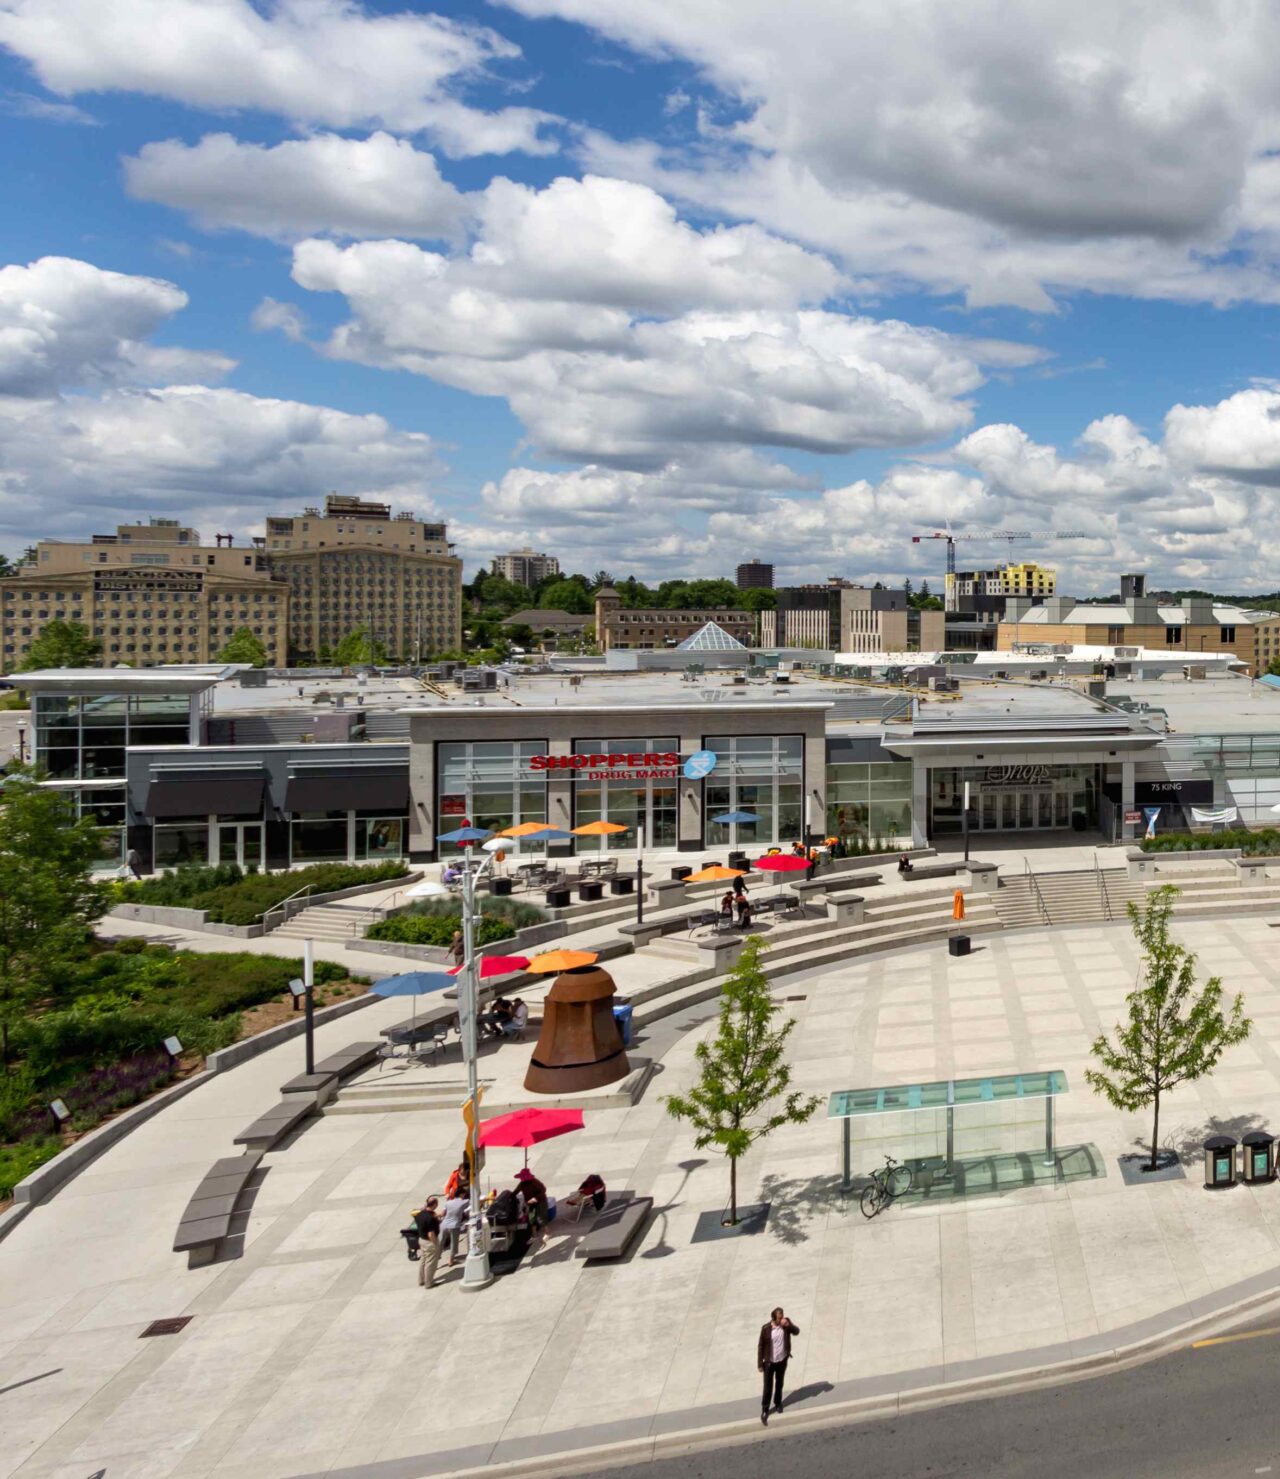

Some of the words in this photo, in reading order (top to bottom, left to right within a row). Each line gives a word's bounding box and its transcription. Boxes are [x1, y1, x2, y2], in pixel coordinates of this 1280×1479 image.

[99, 570, 197, 579] SEAGRAM
[100, 582, 199, 590] DISTILLERS
[529, 752, 680, 770] SHOPPERS
[588, 770, 632, 780] DRUG
[635, 769, 677, 779] MART
[1151, 783, 1160, 791] 75
[1161, 782, 1182, 791] KING
